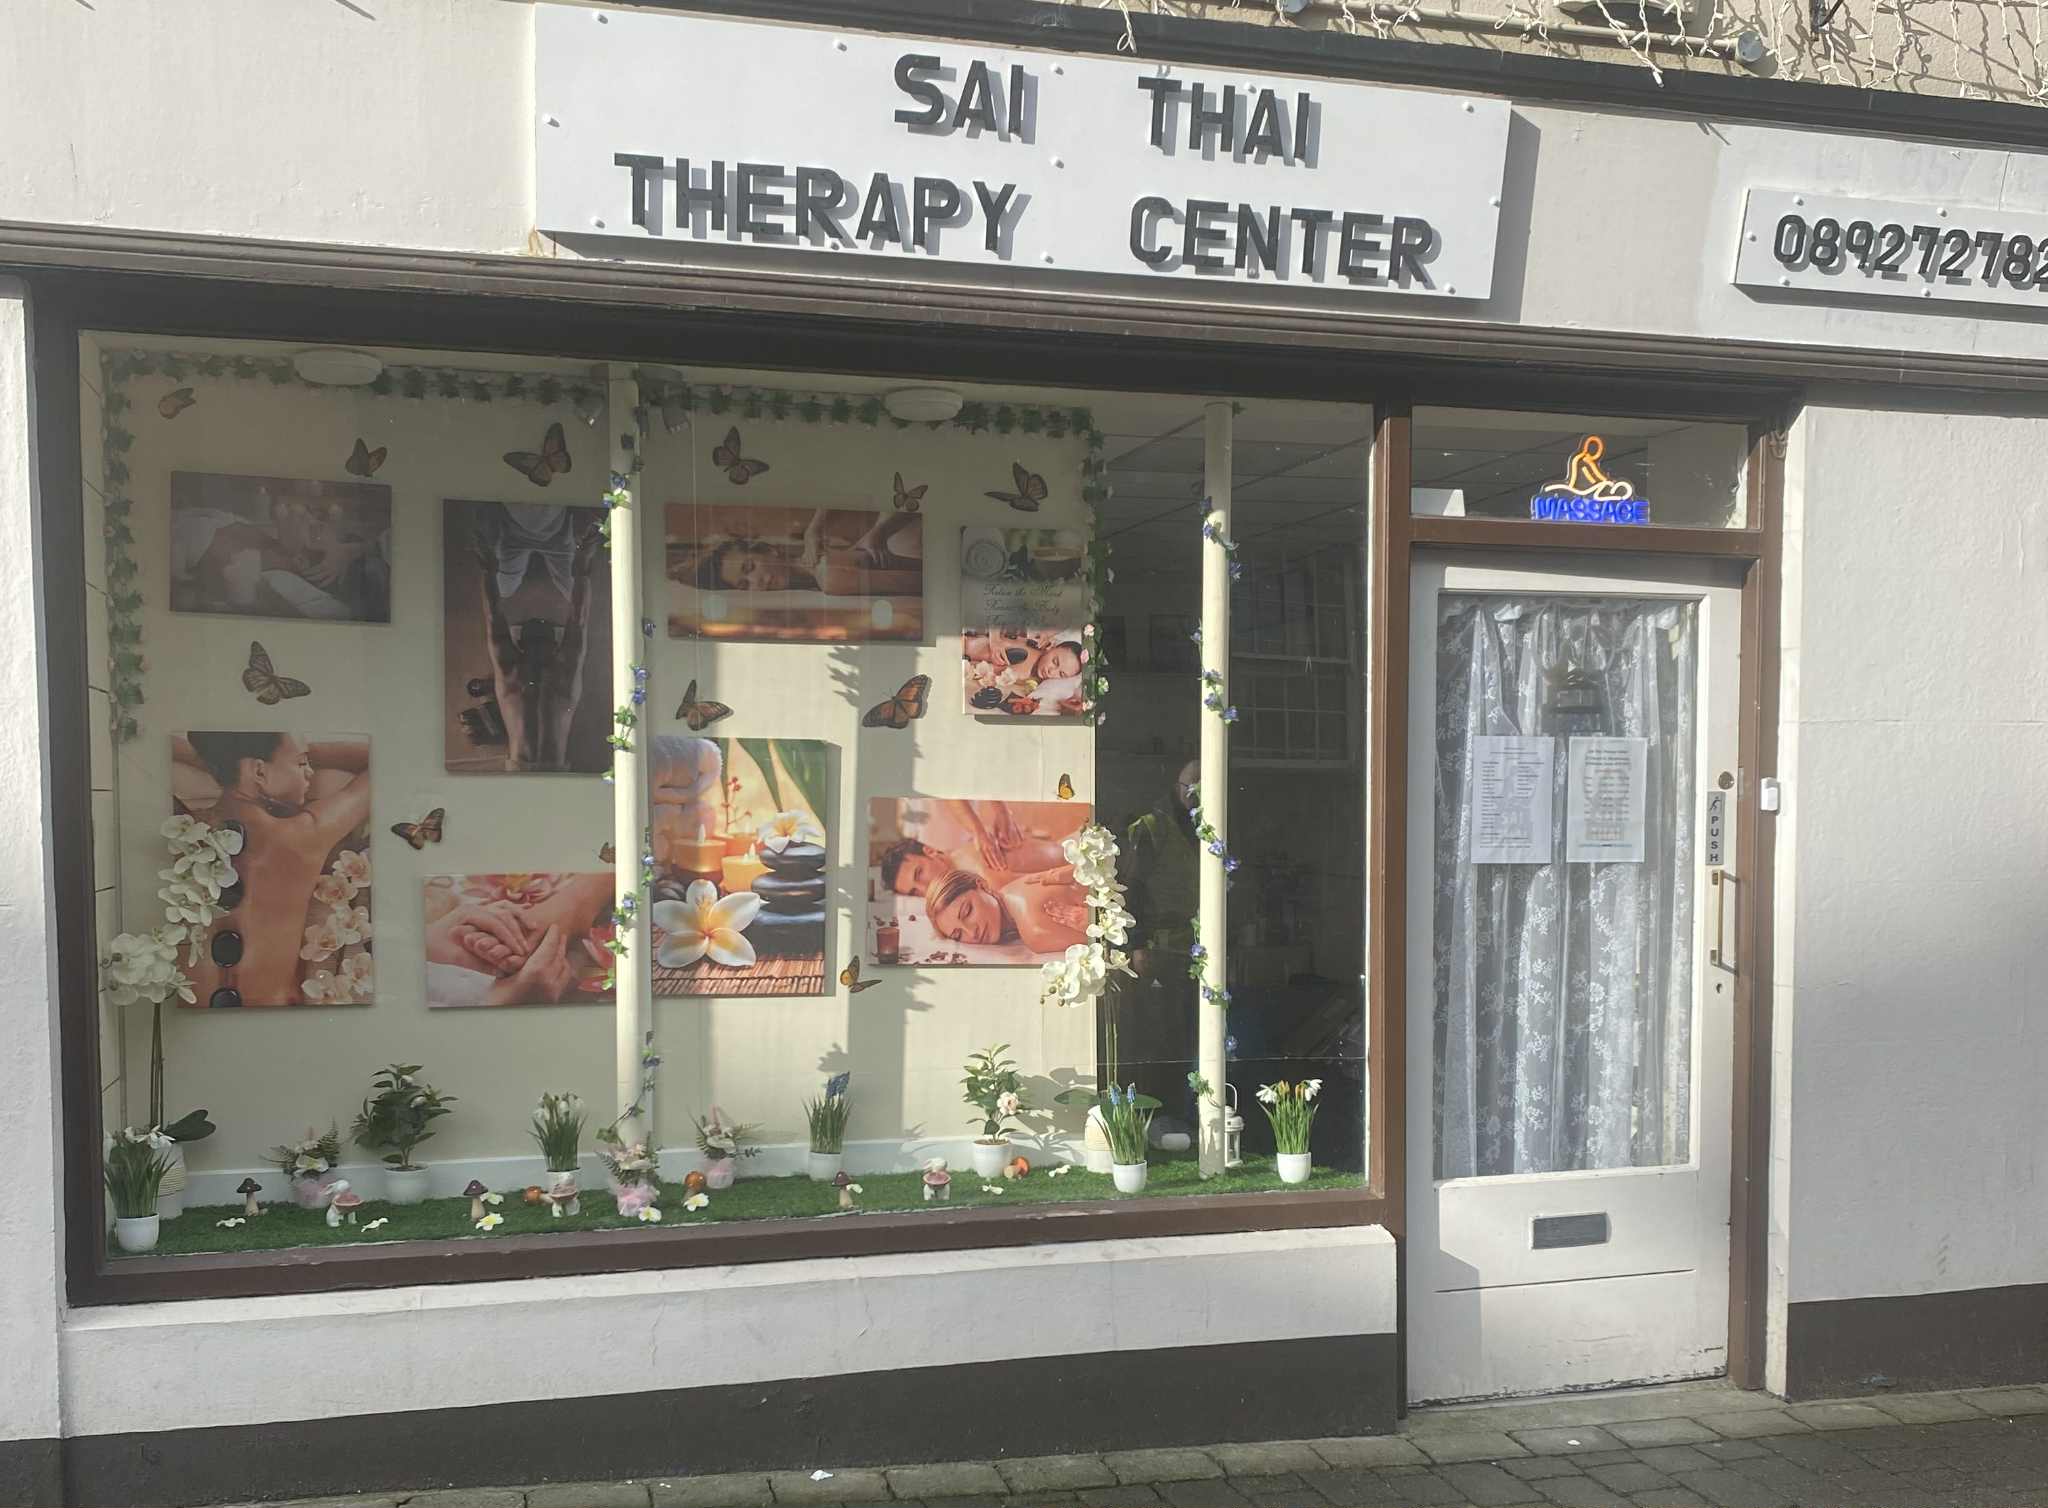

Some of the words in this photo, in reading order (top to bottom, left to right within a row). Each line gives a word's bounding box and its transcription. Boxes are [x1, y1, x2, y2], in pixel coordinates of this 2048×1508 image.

[894, 53, 1024, 135] SAI
[1137, 76, 1310, 160] THAI
[614, 152, 1017, 252] THERAPY
[1129, 196, 1434, 284] CENTER
[1533, 496, 1649, 523] MASSAGE
[1709, 815, 1720, 862] PUSH
